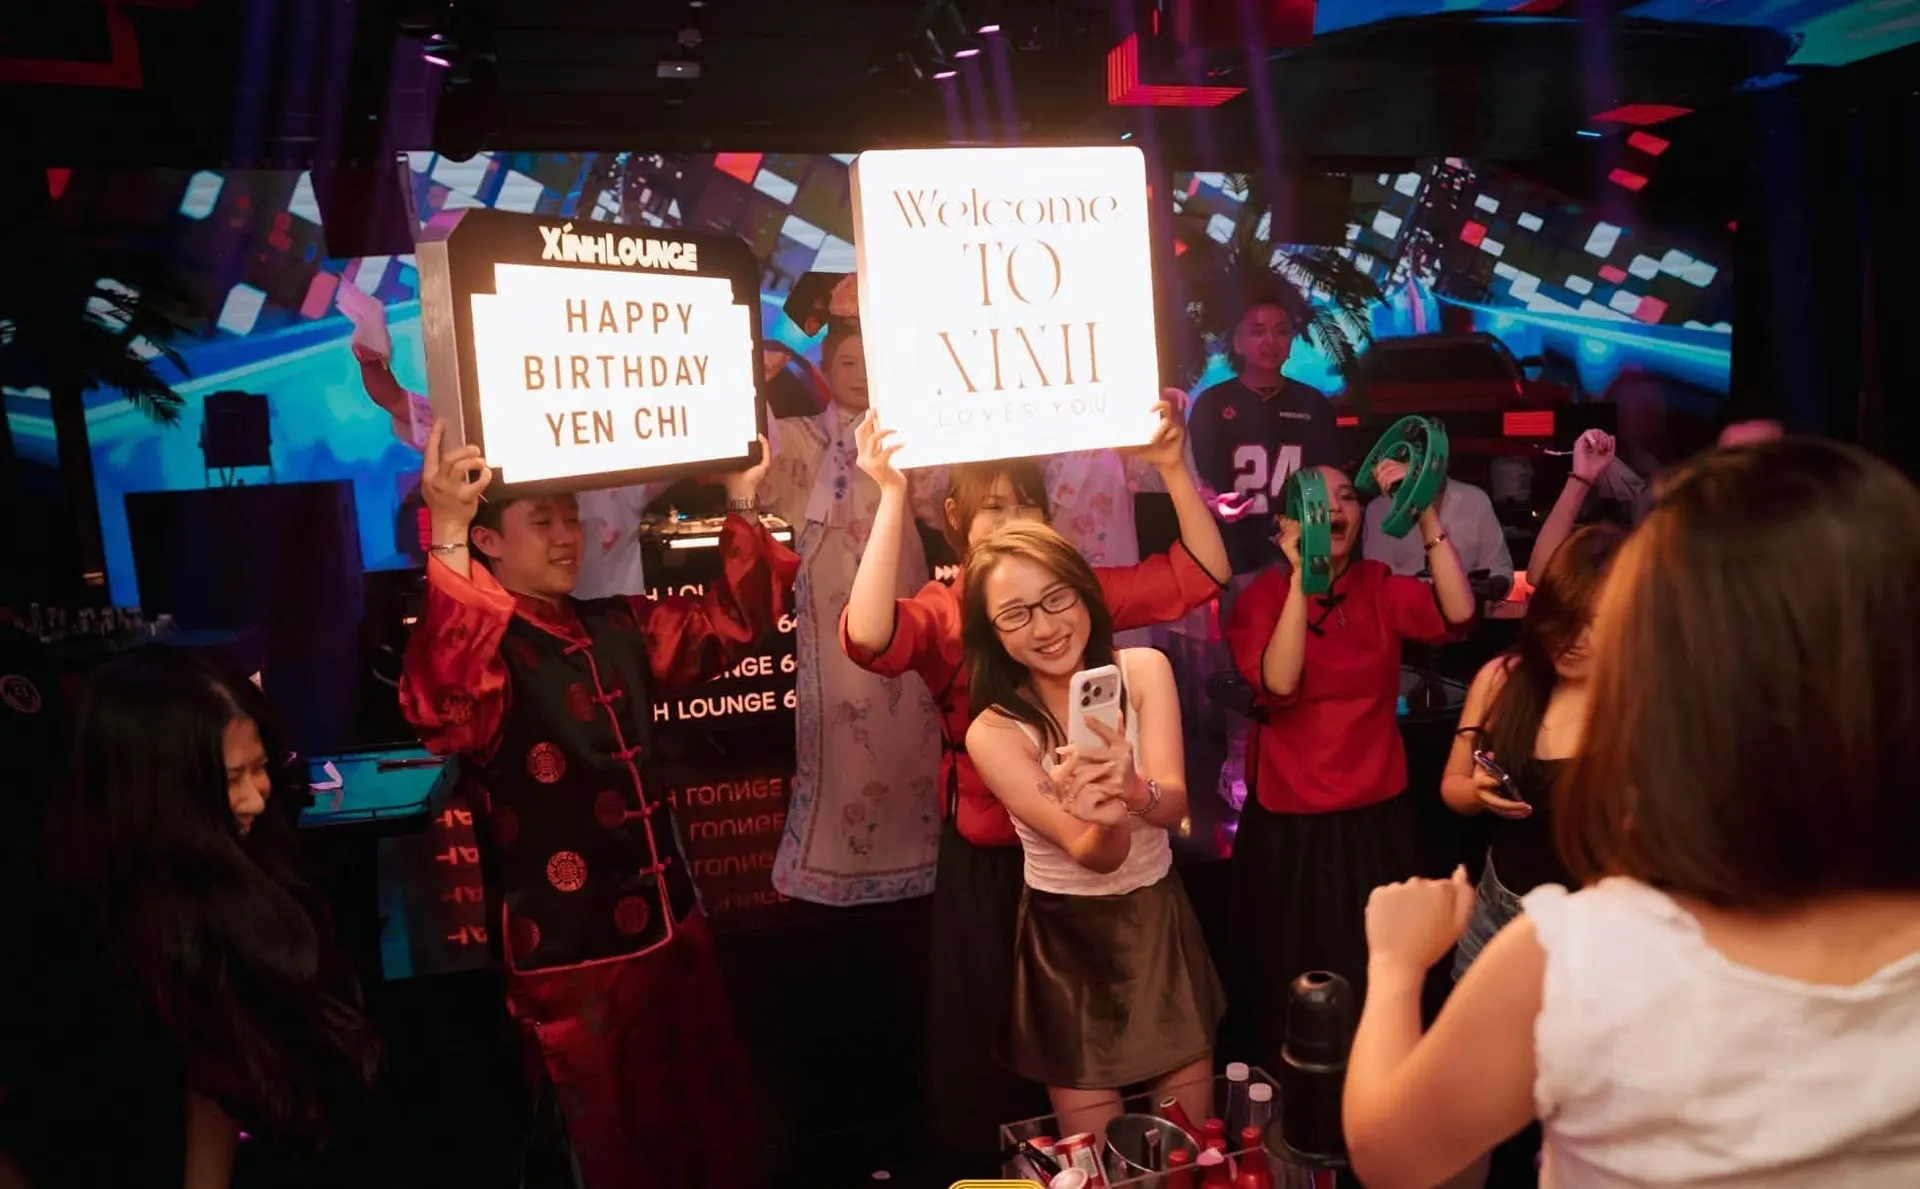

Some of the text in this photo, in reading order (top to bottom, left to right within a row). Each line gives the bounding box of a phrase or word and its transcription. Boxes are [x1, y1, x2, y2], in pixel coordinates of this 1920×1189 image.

[893, 188, 1119, 229] Welcome
[961, 239, 1062, 306] TO
[565, 298, 693, 335] HAPPY
[523, 355, 710, 391] BIRTHDAY
[545, 405, 689, 447] YEN CHI
[935, 391, 1108, 430] LOVES YOU
[678, 691, 777, 720] LOUNGE
